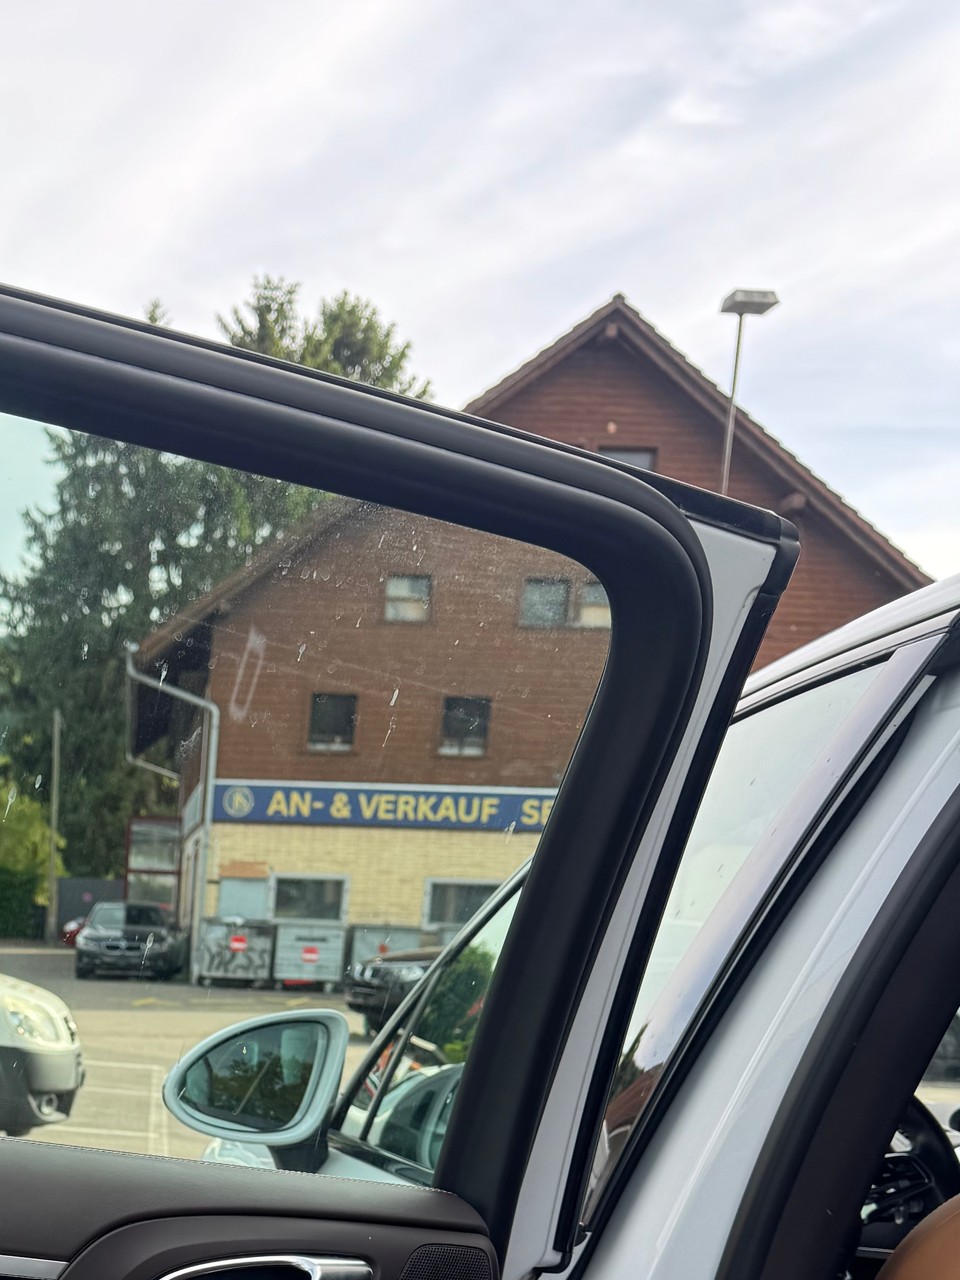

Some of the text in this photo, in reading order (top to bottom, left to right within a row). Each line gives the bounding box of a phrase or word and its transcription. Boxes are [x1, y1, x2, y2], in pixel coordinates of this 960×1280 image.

[266, 790, 324, 817] AN-
[329, 792, 351, 819] &
[358, 793, 500, 824] VERKAUF
